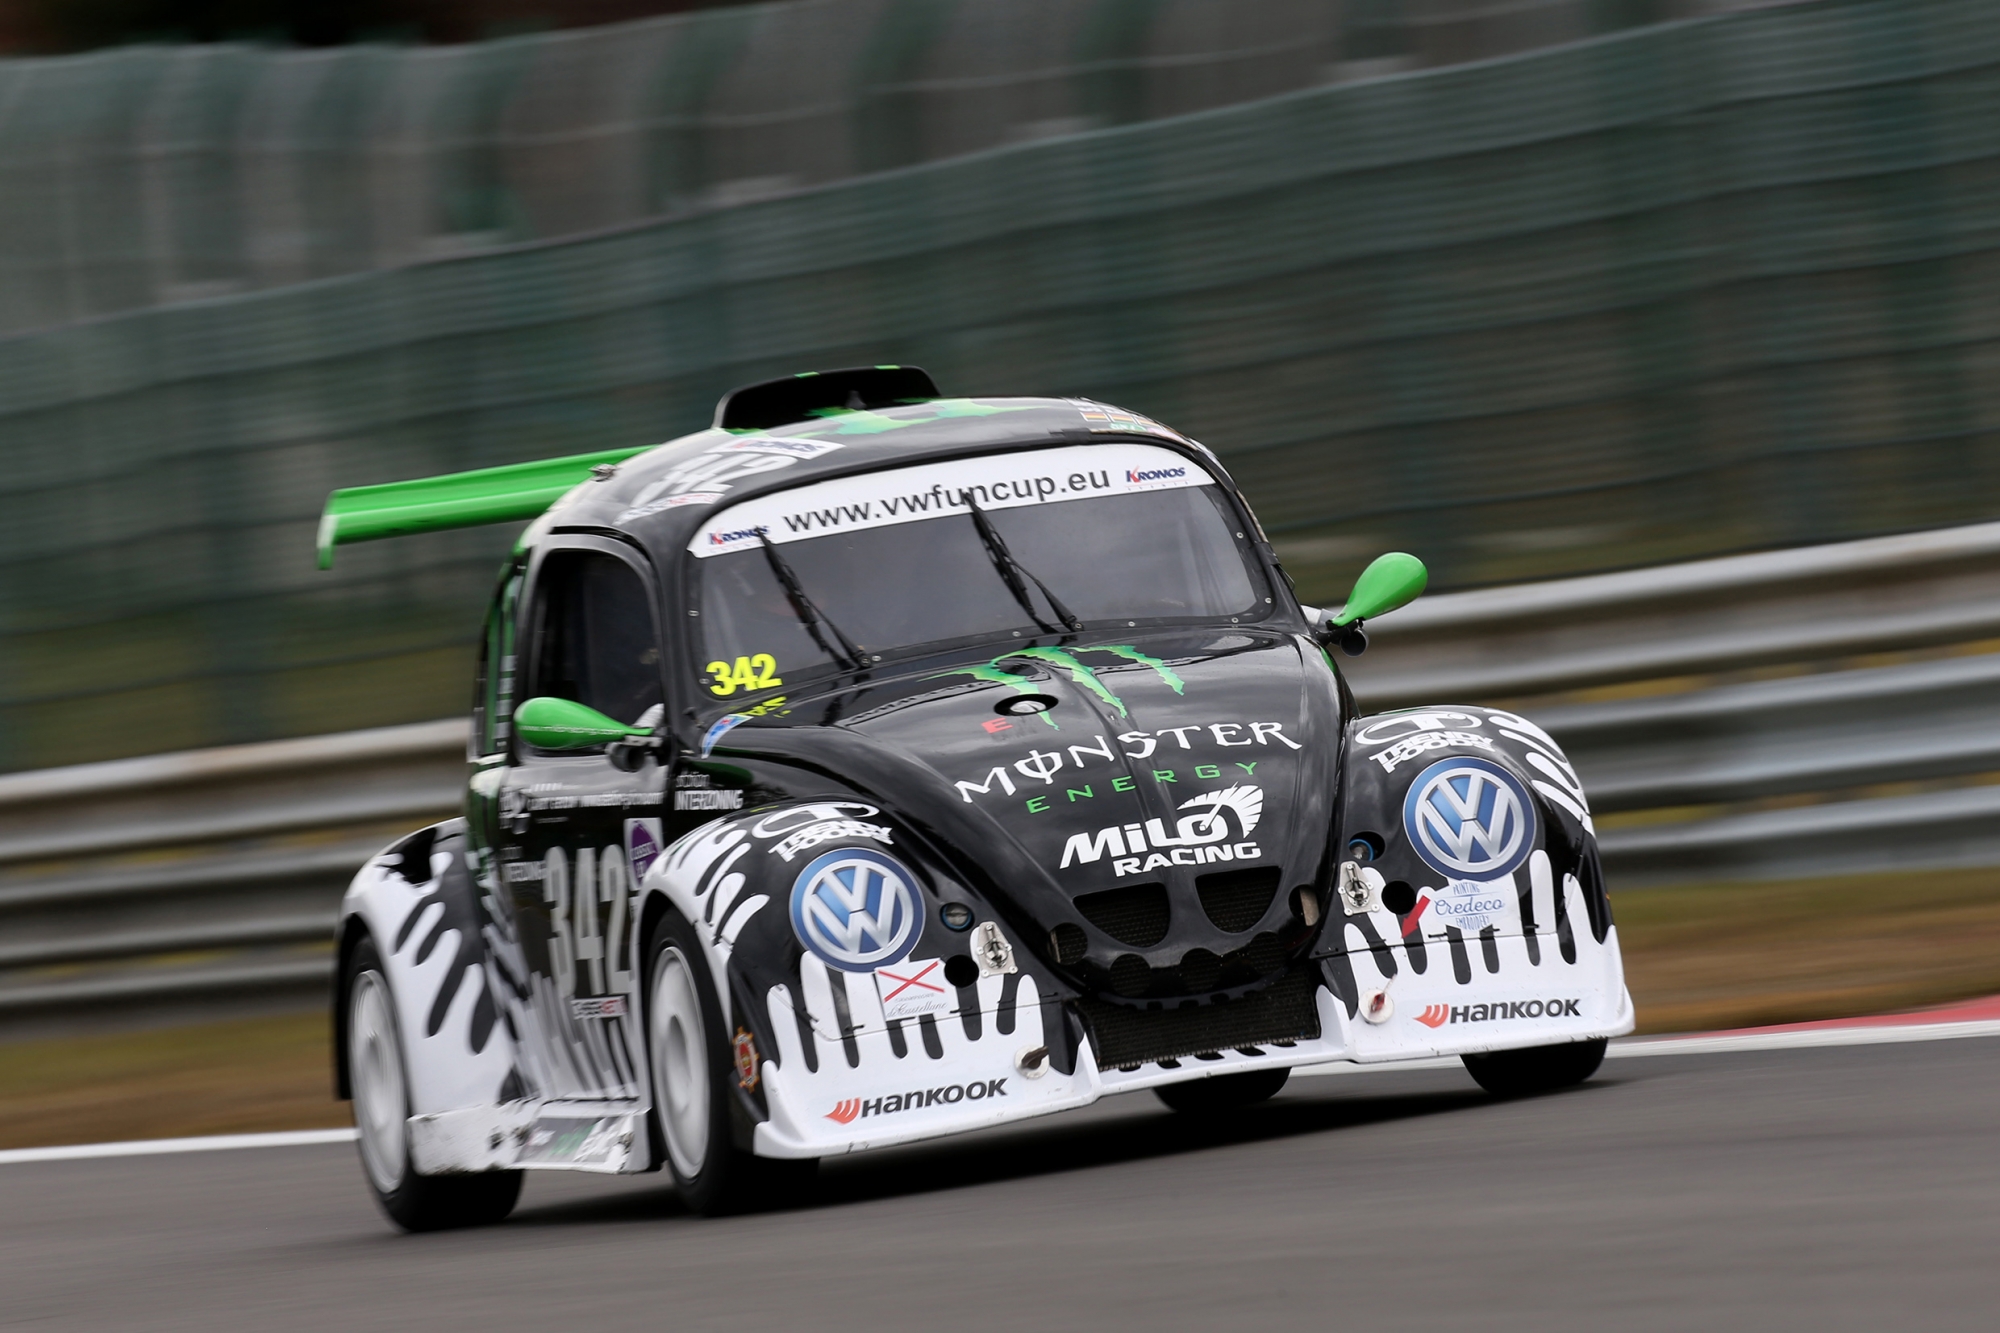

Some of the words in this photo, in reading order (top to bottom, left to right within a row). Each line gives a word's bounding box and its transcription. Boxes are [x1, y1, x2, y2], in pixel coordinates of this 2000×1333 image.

[1125, 465, 1186, 484] KRONOS
[784, 468, 1111, 532] www.vwfuncup.eu
[706, 653, 783, 696] 342
[954, 722, 1303, 804] MONSTER
[1369, 731, 1494, 764] TRENDY
[1026, 762, 1258, 814] ENERGY
[1113, 841, 1262, 878] RACING
[1434, 897, 1505, 916] Credeco
[1453, 882, 1481, 895] PRINTING
[544, 845, 631, 996] 342
[1455, 914, 1490, 931] EMBROIDERY
